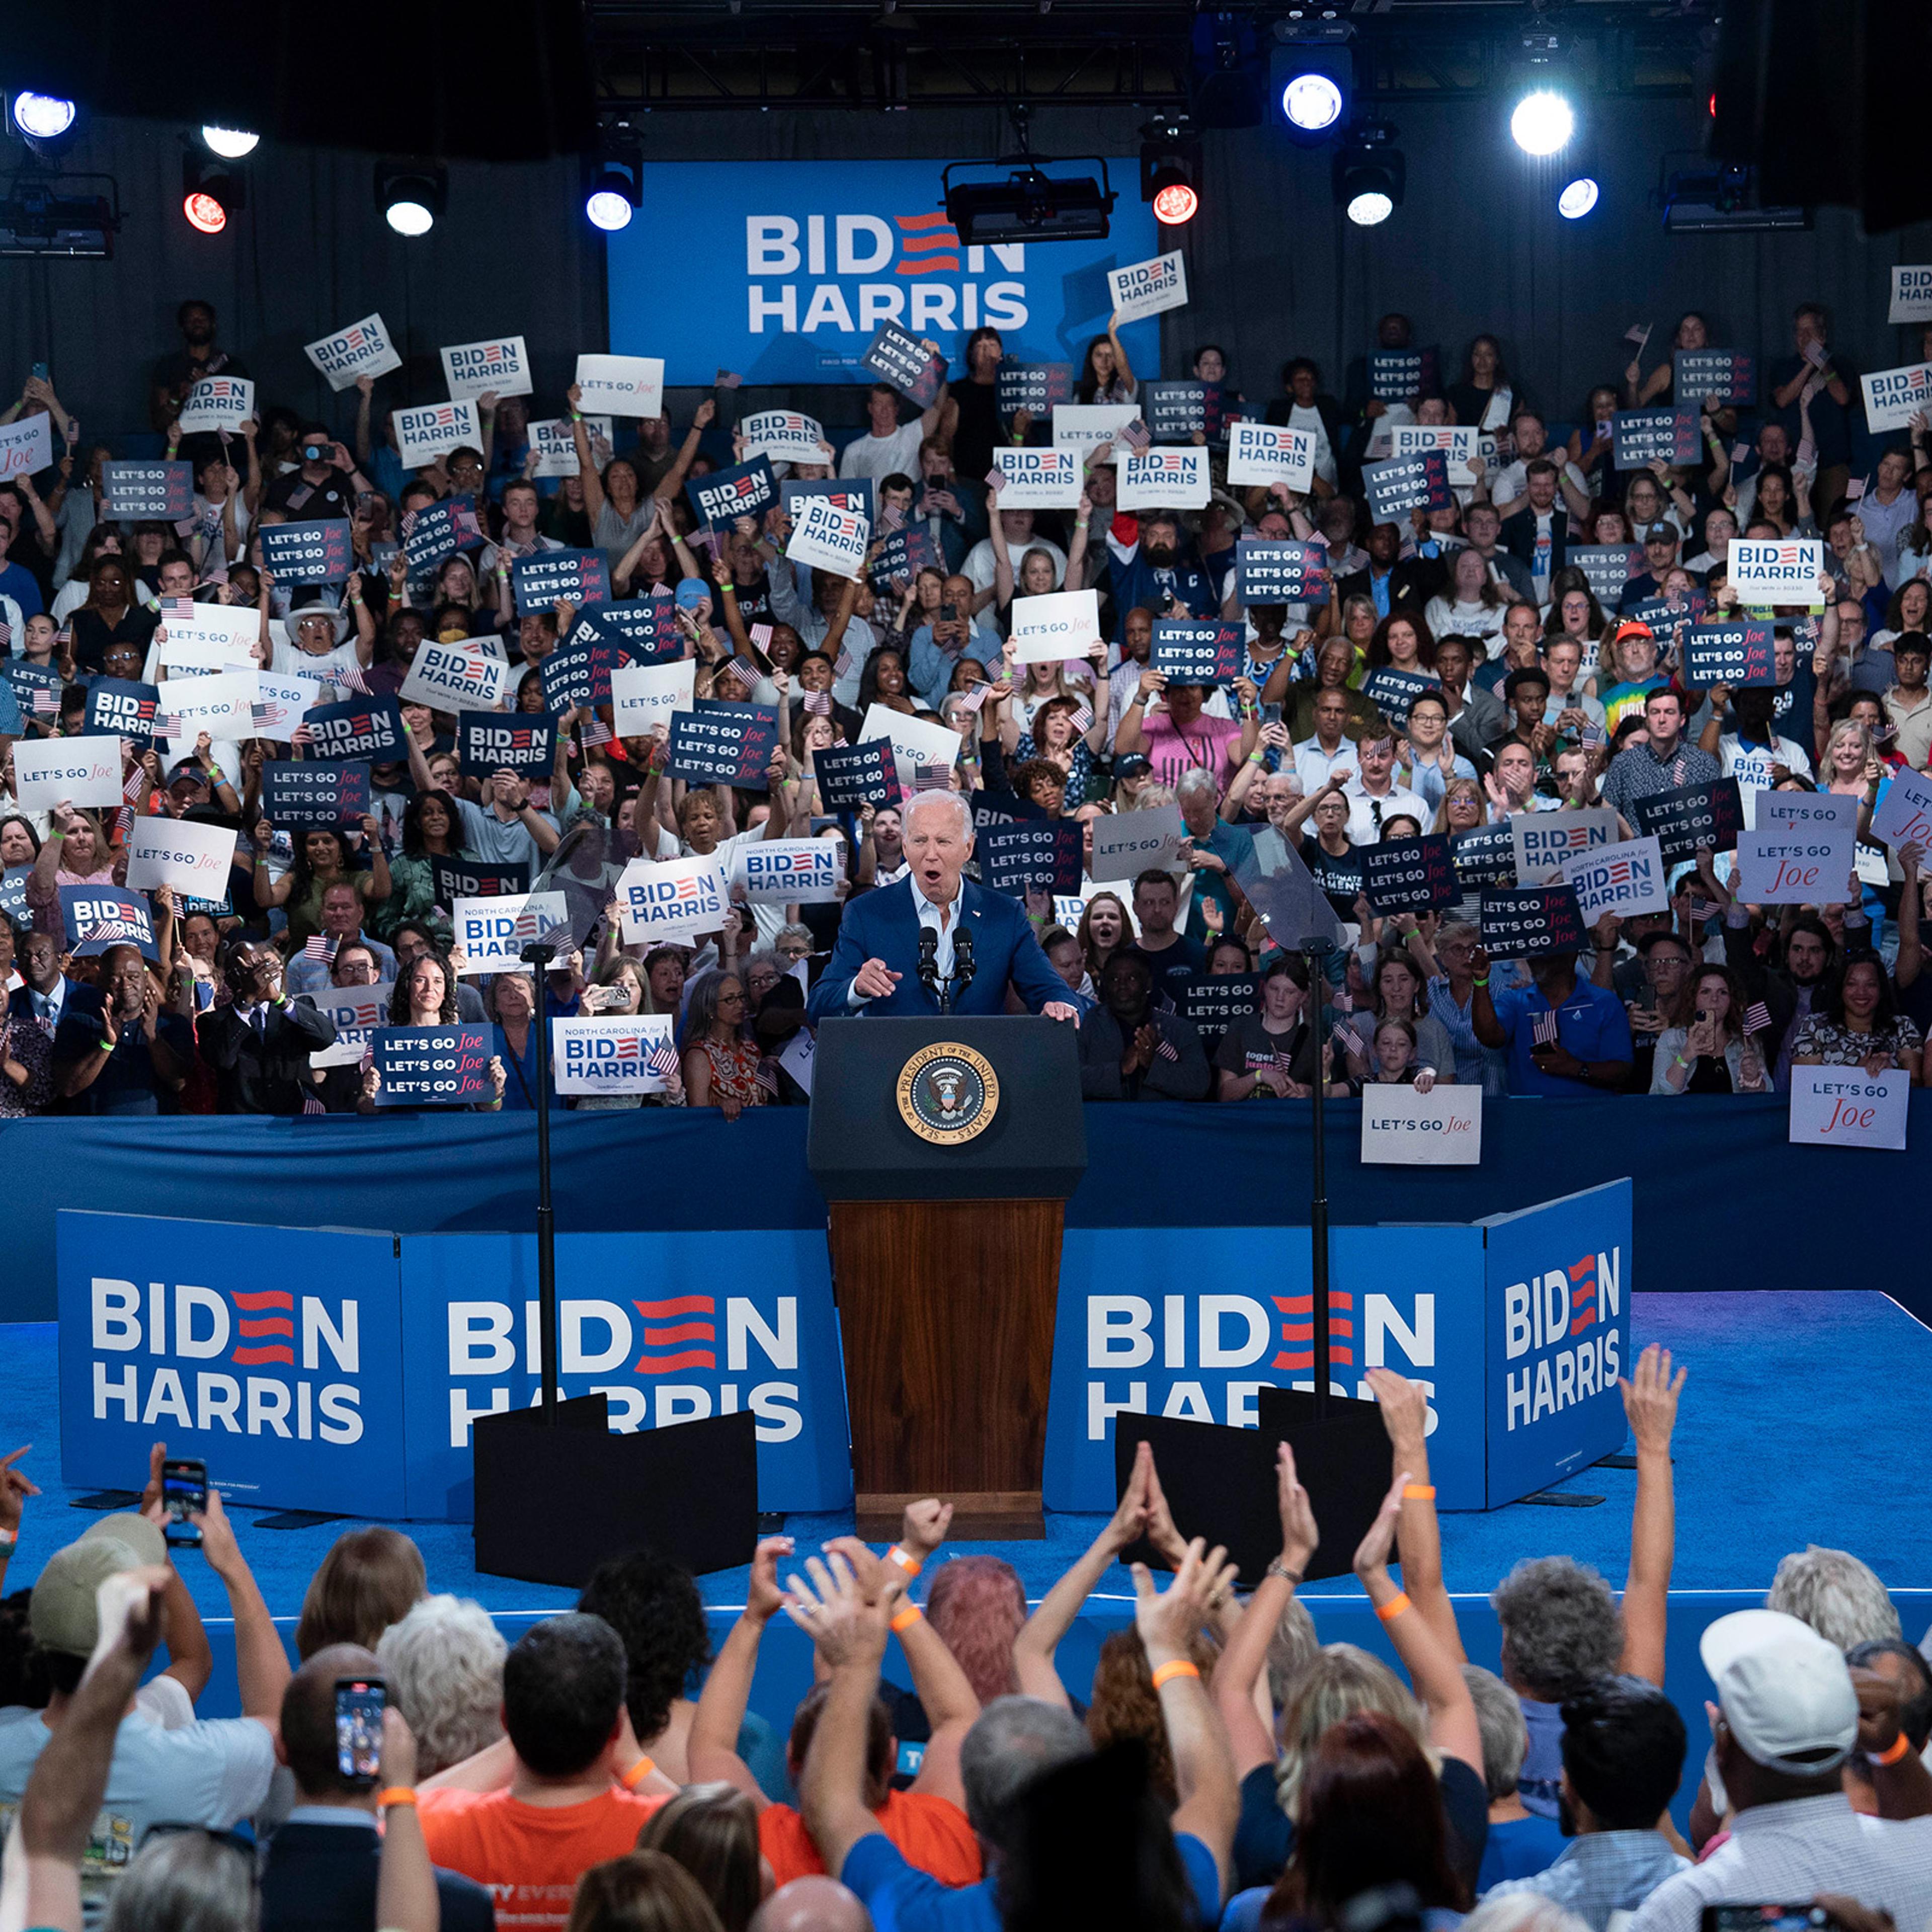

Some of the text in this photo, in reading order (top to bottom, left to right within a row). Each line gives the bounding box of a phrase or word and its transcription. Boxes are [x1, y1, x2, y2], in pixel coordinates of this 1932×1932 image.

[1117, 258, 1175, 289] BIDEN
[1120, 275, 1178, 302] HARRIS
[748, 281, 1029, 333] HARRIS
[314, 324, 378, 362] BIDEN
[324, 339, 384, 373] HARRIS
[450, 345, 516, 367] BIDEN
[453, 361, 519, 380] HARRIS
[581, 380, 655, 395] LET'S GO Joe
[402, 407, 469, 430] BIDEN
[750, 416, 818, 432] BIDEN
[404, 423, 471, 445] HARRIS
[750, 431, 819, 444] HARRIS
[1240, 431, 1307, 452] BIDEN
[1400, 432, 1467, 447] BIDEN
[1, 447, 34, 474] Joe
[1003, 453, 1074, 469] BIDEN
[1128, 455, 1196, 471] BIDEN
[1239, 448, 1306, 467] HARRIS
[698, 469, 768, 506] BIDEN
[1004, 471, 1074, 484] HARRIS
[1127, 471, 1197, 485] HARRIS
[704, 485, 771, 521] HARRIS
[810, 507, 865, 540] BIDEN
[268, 528, 342, 544] LET'S GO Joe
[803, 524, 863, 555] HARRIS
[522, 556, 599, 575] LET'S GO Joe
[1246, 548, 1320, 563] LET'S GO Joe
[1739, 547, 1814, 564] BIDEN
[1738, 566, 1815, 579] HARRIS
[1017, 617, 1090, 636] LET'S GO Joe
[1160, 629, 1238, 645] LET'S GO Joe
[169, 629, 251, 647] LET'S GO Joe
[1691, 629, 1765, 646] LET'S GO Joe
[425, 650, 498, 684] BIDEN
[418, 667, 495, 700] HARRIS
[621, 696, 658, 708] LET'S
[662, 694, 676, 704] GO
[311, 711, 391, 741] BIDEN
[680, 722, 766, 742] LET'S GO Joe
[313, 731, 395, 758] HARRIS
[470, 728, 547, 748] BIDEN
[470, 748, 546, 763] HARRIS
[677, 740, 763, 761] LET'S GO Joe
[24, 763, 112, 782] LET'S GO Joe
[274, 770, 361, 786] LET'S GO Joe
[1770, 807, 1836, 821] LET'S GO
[989, 834, 1029, 847] LET'S
[1031, 832, 1053, 843] GO
[1100, 842, 1138, 854] LET'S
[1140, 839, 1158, 850] GO
[1524, 826, 1606, 849] BIDEN
[136, 848, 222, 870] LET'S GO Joe
[1368, 843, 1441, 867] LET'S GO Joe
[1758, 846, 1831, 857] LET'S GO
[747, 853, 833, 872] BIDEN
[1570, 861, 1594, 874] NORTH
[1595, 851, 1636, 867] CAROLINA
[441, 870, 518, 894] BIDEN
[748, 872, 834, 891] HARRIS
[1574, 859, 1650, 895] BIDEN
[1765, 860, 1819, 893] Joe
[628, 875, 714, 905] BIDEN
[1578, 881, 1654, 911] HARRIS
[497, 905, 544, 915] CAROLINA
[632, 896, 720, 923] HARRIS
[1484, 894, 1567, 913] LET'S GO Joe
[73, 901, 148, 929] BIDEN
[385, 1032, 482, 1053] LET'S GO Joe
[566, 1037, 659, 1059] BIDEN
[958, 1049, 972, 1059] THE
[568, 1063, 660, 1078] HARRIS
[901, 1046, 944, 1092] PRESIDENT
[974, 1058, 995, 1098] UNITED
[387, 1075, 484, 1094] LET'S GO Joe
[1813, 1082, 1887, 1097] LET'S GO
[907, 1111, 914, 1120] OF
[958, 1107, 991, 1138] STATES
[1372, 1116, 1471, 1134] LET'S GO Joe
[1820, 1098, 1876, 1133] Joe
[915, 1122, 940, 1139] SEAL
[1506, 1247, 1620, 1359] BIDEN
[91, 1277, 360, 1373] BIDEN
[448, 1296, 797, 1375] BIDEN
[1088, 1291, 1435, 1370] BIDEN
[1507, 1330, 1620, 1431] HARRIS
[93, 1361, 364, 1445] HARRIS
